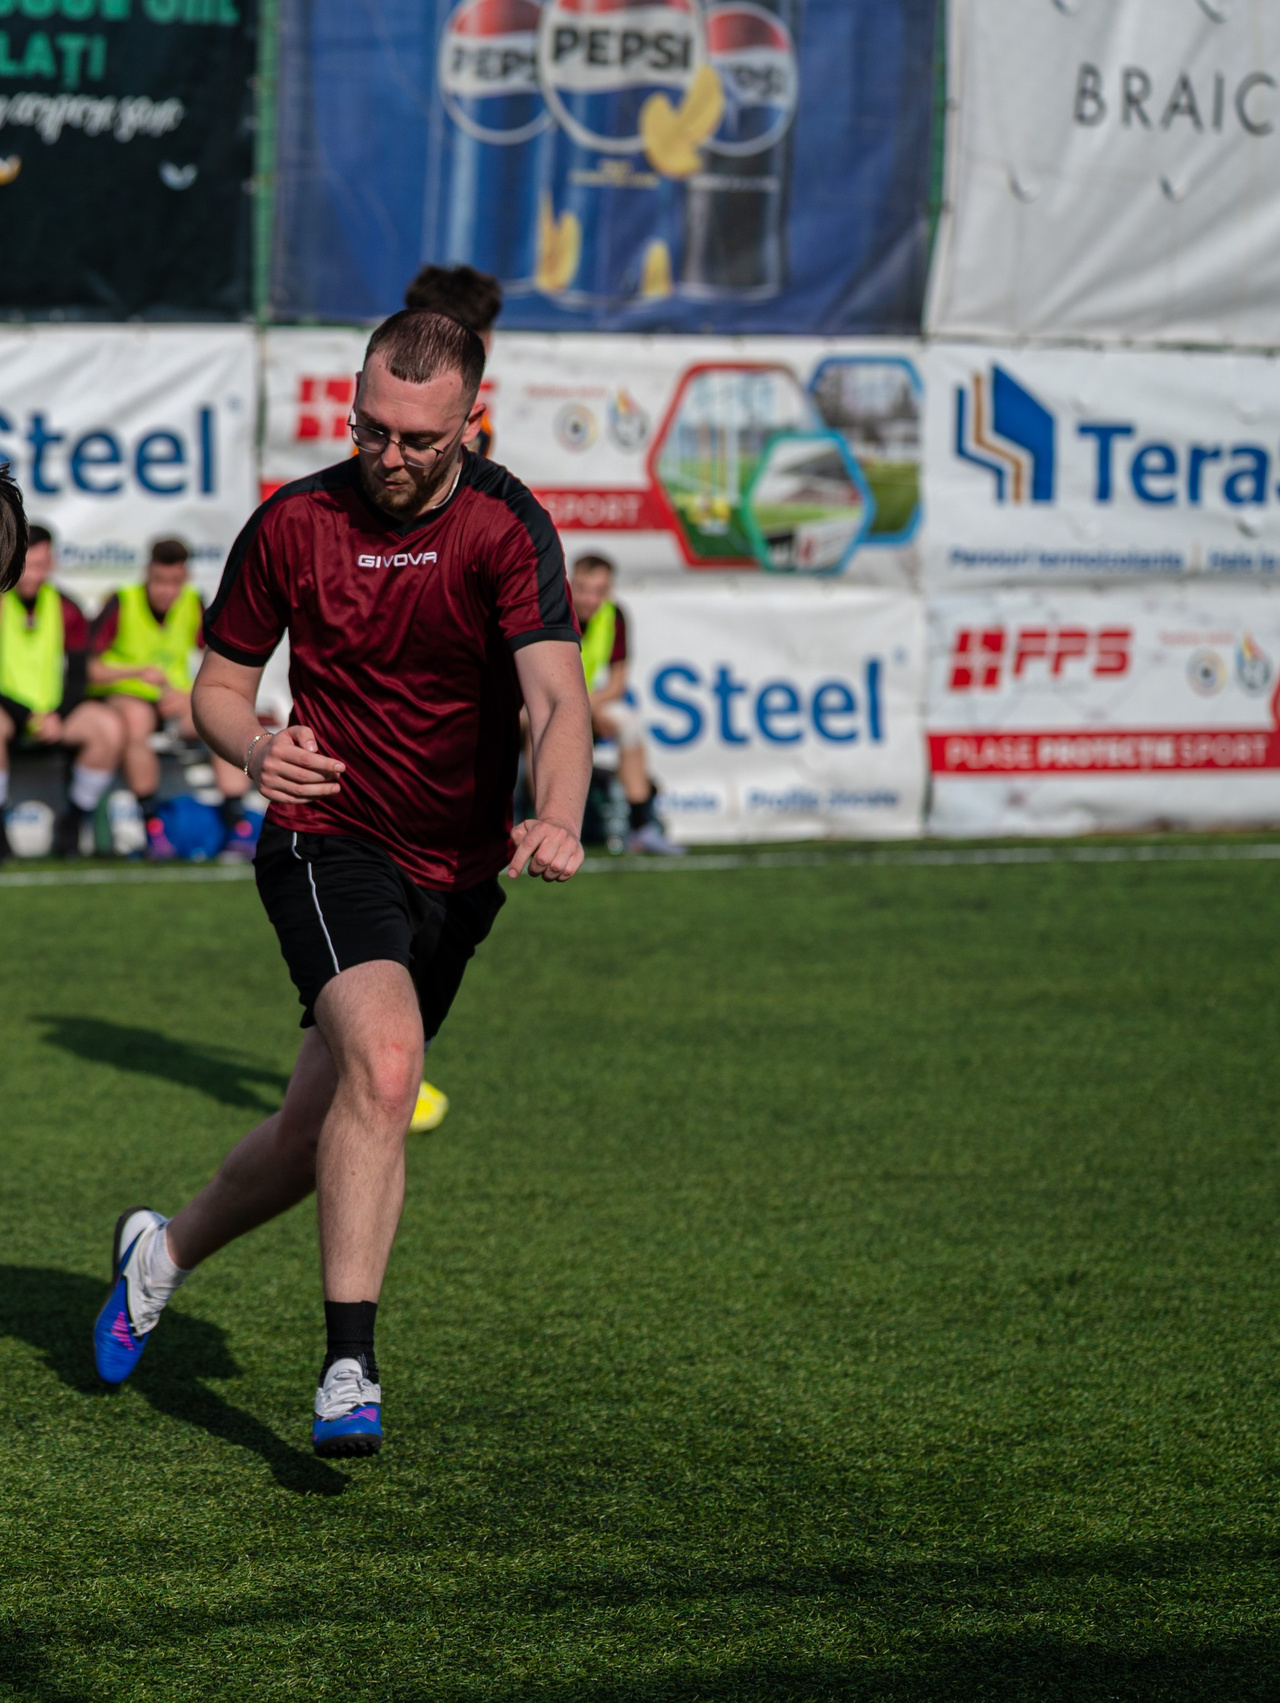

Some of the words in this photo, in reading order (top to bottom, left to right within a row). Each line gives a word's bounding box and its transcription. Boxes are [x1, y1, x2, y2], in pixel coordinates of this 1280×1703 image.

[552, 26, 692, 70] PEPSI
[1077, 424, 1280, 507] Tera
[357, 552, 438, 569] GIVOVA
[1013, 629, 1133, 678] FPS
[626, 658, 883, 747] Steel
[946, 737, 1034, 769] PLASE
[1177, 734, 1266, 766] SPORT
